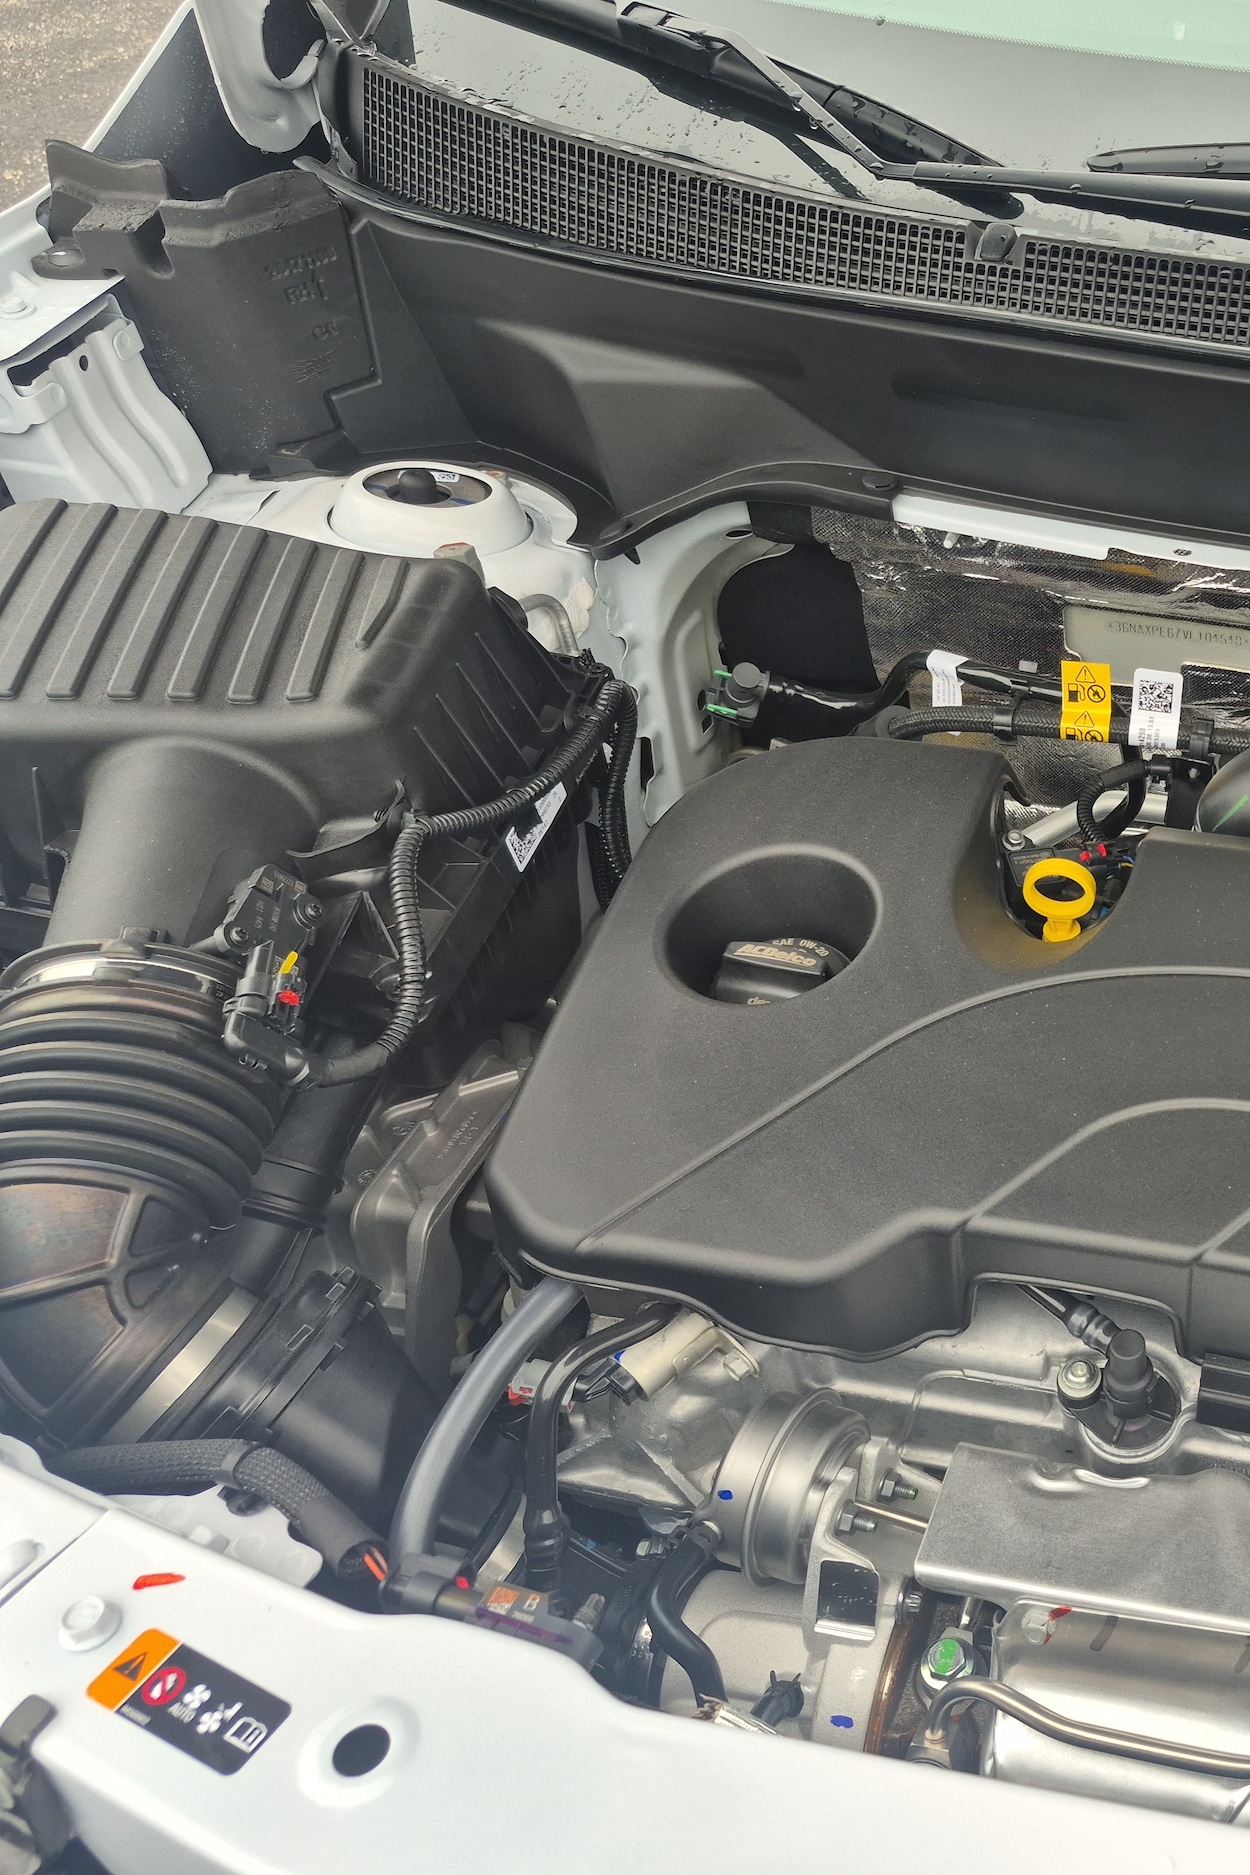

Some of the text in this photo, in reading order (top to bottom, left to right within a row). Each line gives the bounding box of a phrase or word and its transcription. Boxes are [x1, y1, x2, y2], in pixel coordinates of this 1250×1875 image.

[735, 944, 817, 968] ACDelco
[772, 938, 830, 958] SAE 0W-20
[167, 1702, 197, 1724] AUTO
